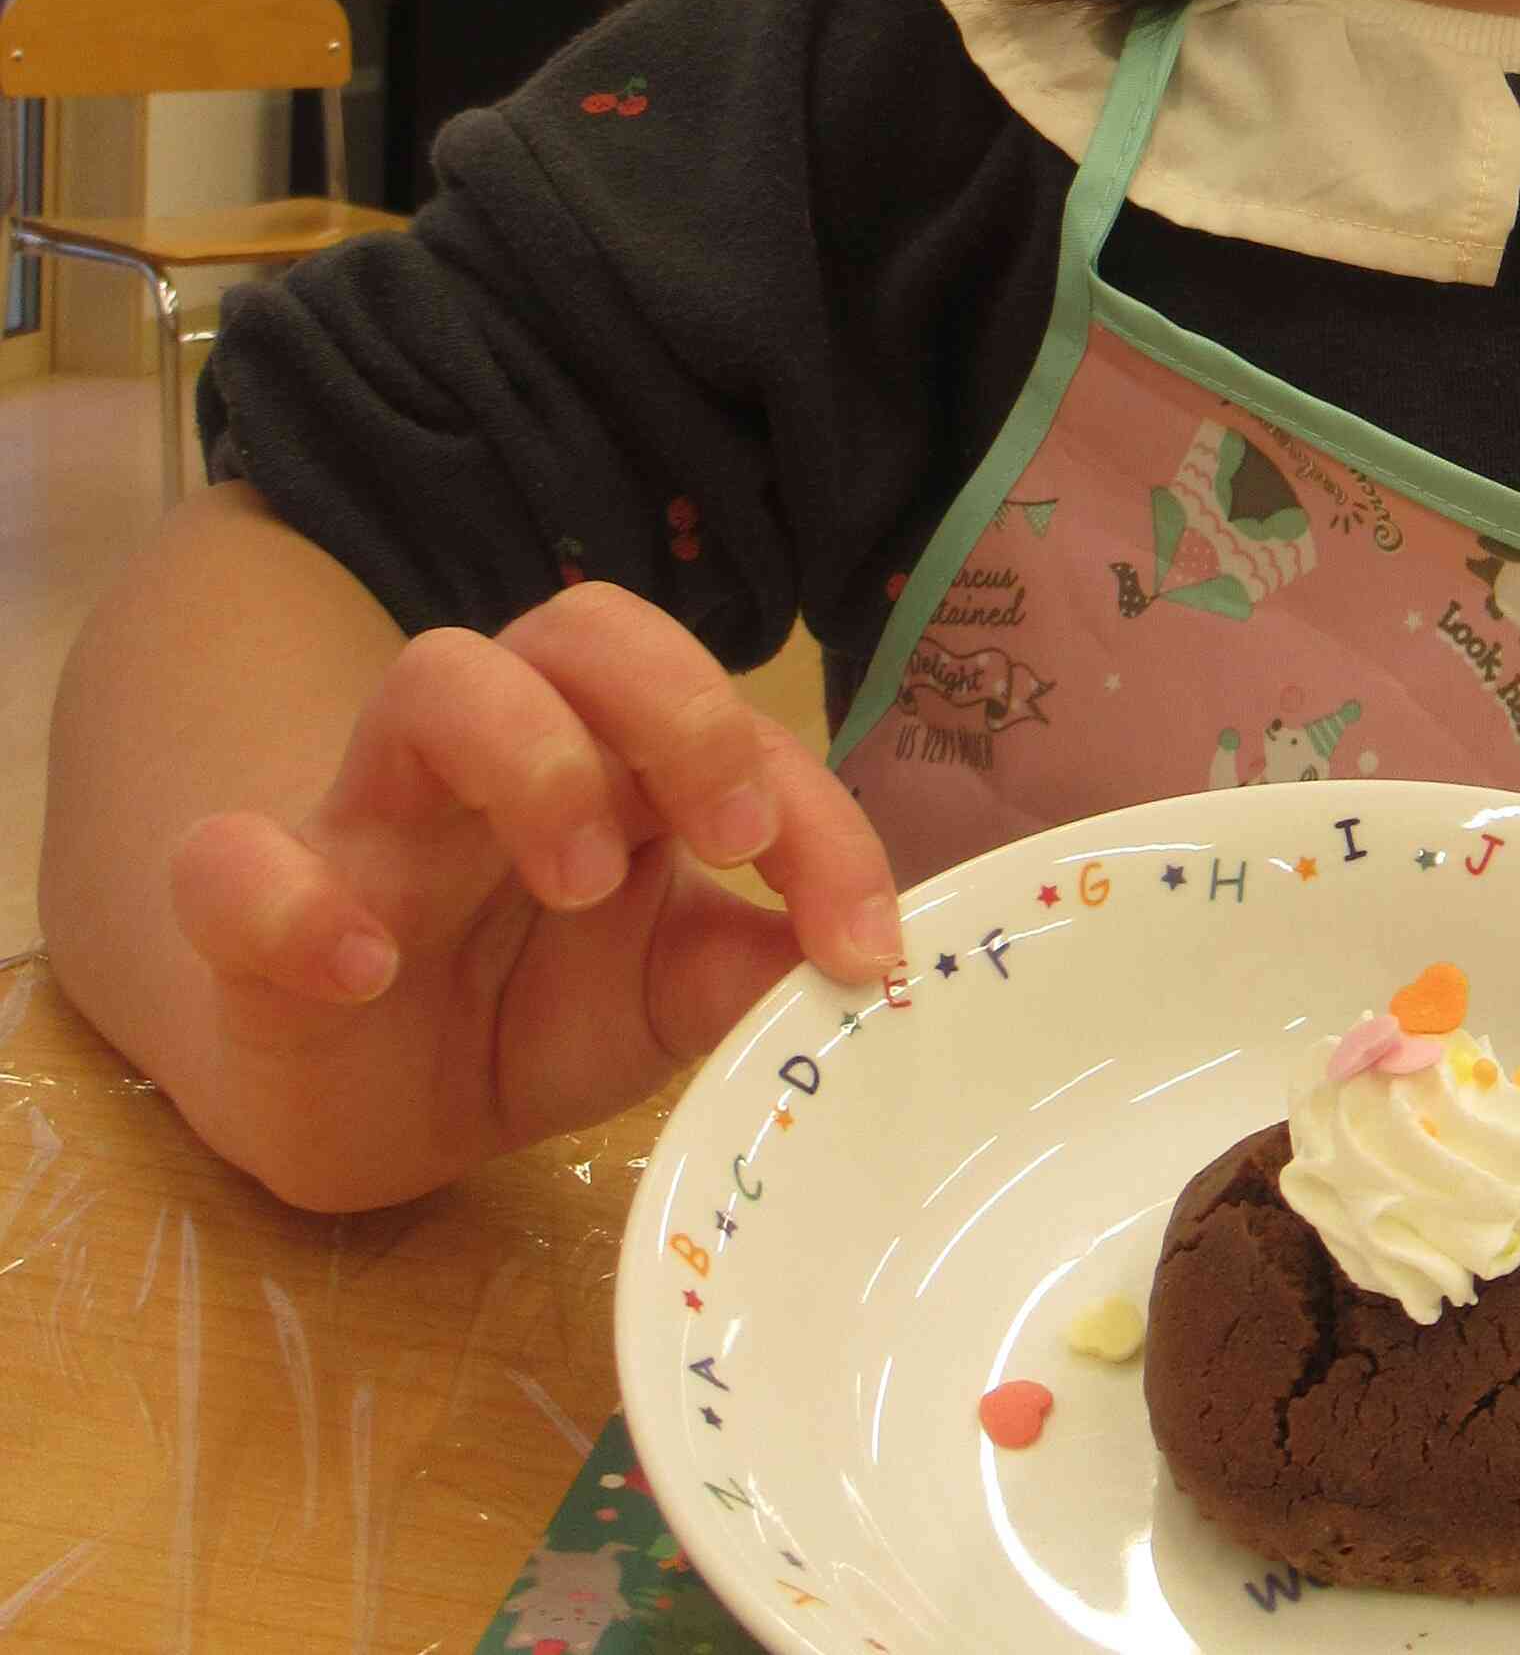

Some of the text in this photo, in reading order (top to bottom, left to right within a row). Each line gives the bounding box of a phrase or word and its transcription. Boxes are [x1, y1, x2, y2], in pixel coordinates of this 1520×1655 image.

[953, 568, 1019, 588] rcus
[1438, 599, 1502, 682] Look
[669, 1233, 710, 1280] B
[733, 1154, 763, 1201] C
[778, 1054, 821, 1095] D
[1078, 861, 1111, 908] G
[1210, 857, 1247, 903] H
[1334, 818, 1368, 862] I
[1464, 833, 1505, 876] J
